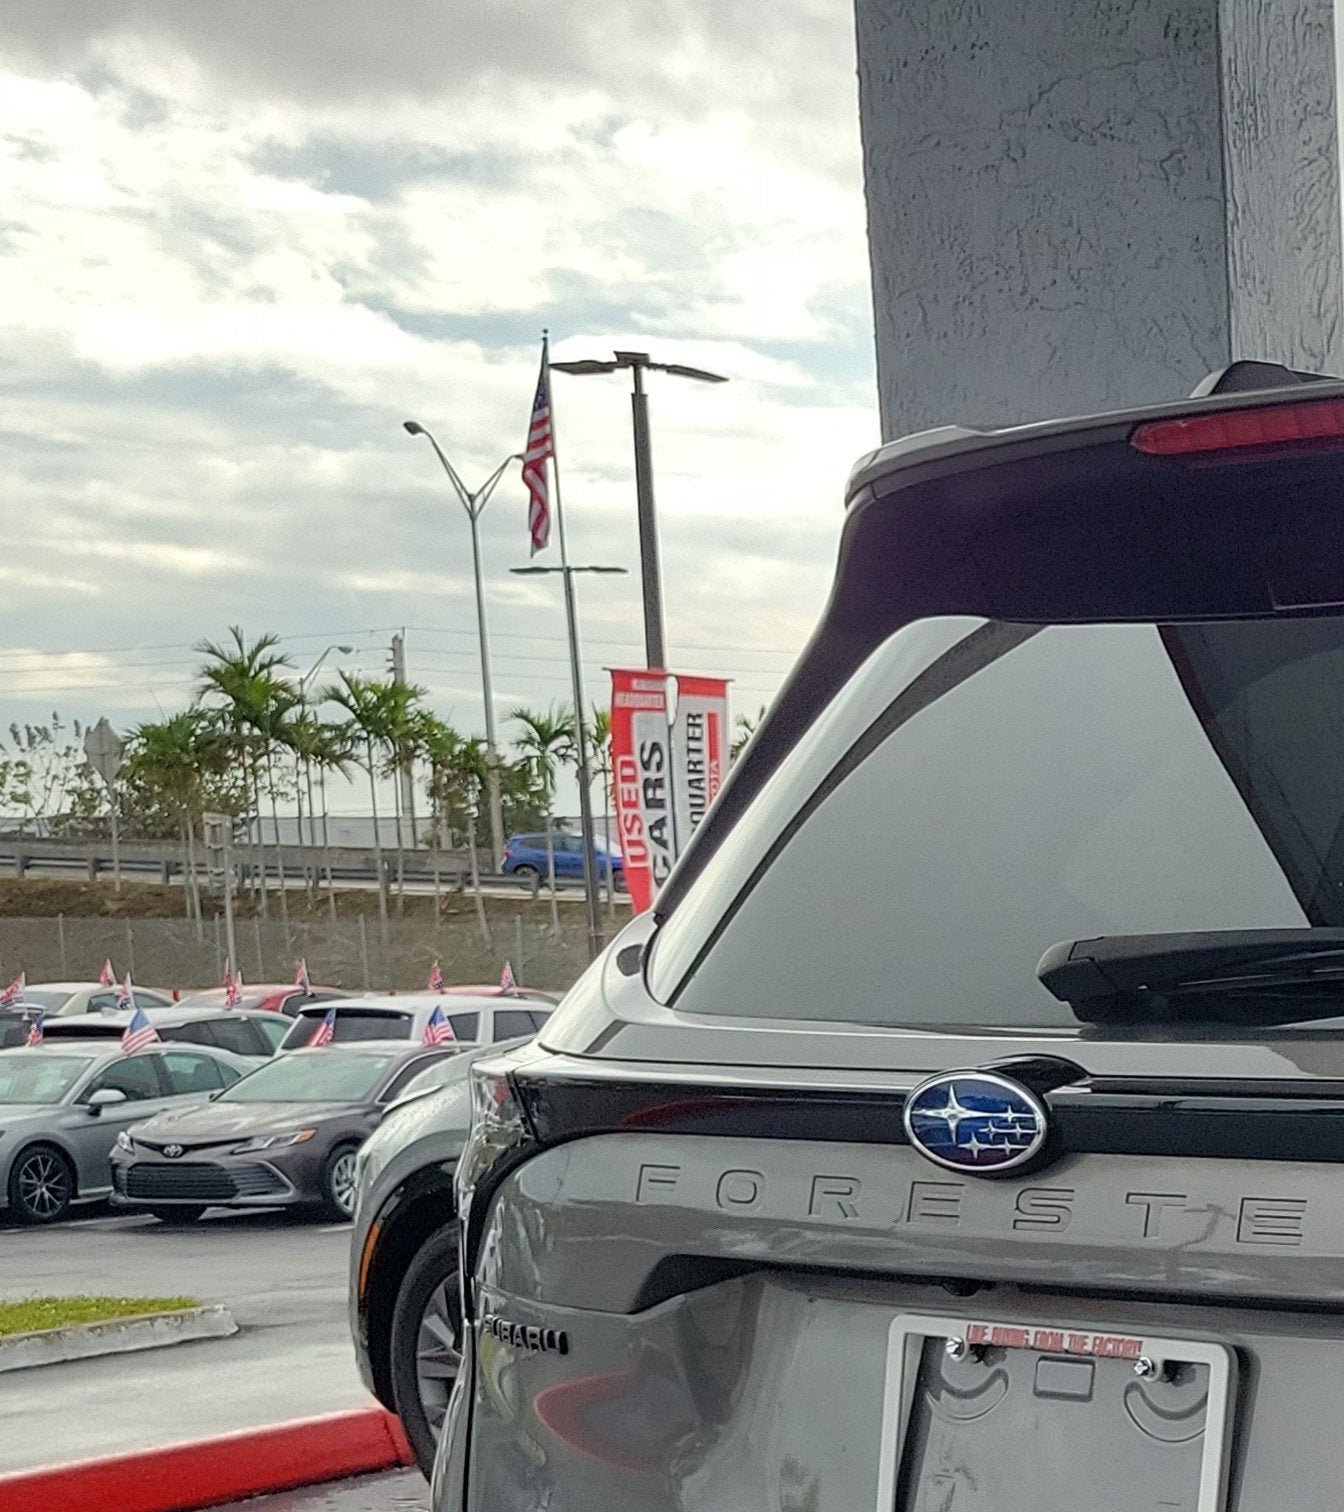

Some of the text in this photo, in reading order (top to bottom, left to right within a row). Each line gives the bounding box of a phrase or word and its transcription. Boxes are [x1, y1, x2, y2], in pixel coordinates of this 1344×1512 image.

[620, 759, 648, 865] USED
[640, 741, 671, 888] CARS
[687, 712, 706, 834] QUARTER
